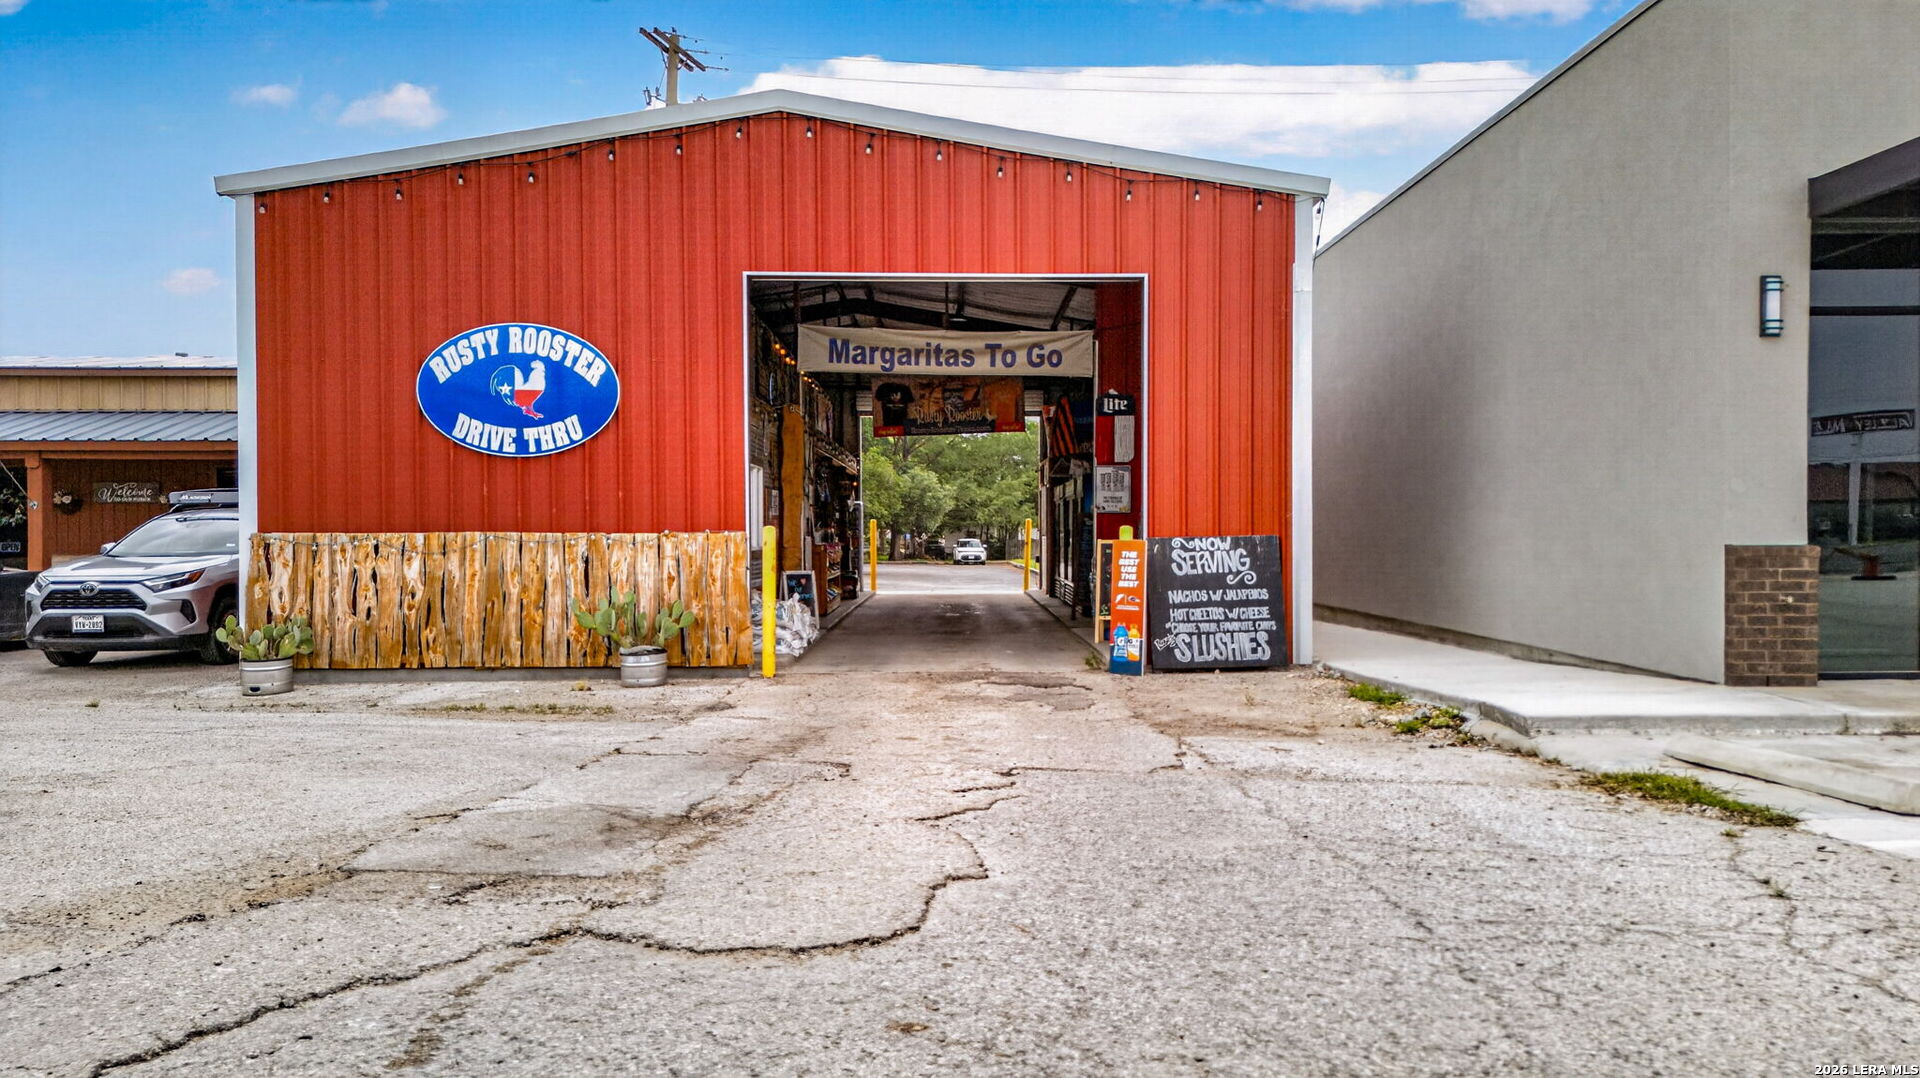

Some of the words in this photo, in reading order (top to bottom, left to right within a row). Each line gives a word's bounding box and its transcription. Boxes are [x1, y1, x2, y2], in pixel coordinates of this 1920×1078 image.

[428, 328, 499, 384] RUSTY
[508, 326, 607, 387] ROOSTER
[828, 338, 976, 373] Margaritas
[984, 343, 1017, 369] To
[1026, 343, 1063, 369] Go
[1103, 397, 1128, 413] Lite
[451, 412, 517, 453] DRIVE
[523, 414, 583, 453] THRU
[1194, 537, 1231, 551] NOW
[1171, 548, 1250, 577] SERVING
[1167, 589, 1208, 604] NACHOS
[1209, 589, 1223, 601] W/
[1169, 608, 1189, 621] HOT
[1189, 607, 1225, 620] CHEETOS
[1225, 607, 1239, 619] W/
[1240, 606, 1271, 619] CHEESE
[1174, 631, 1272, 663] SLUSHIES
